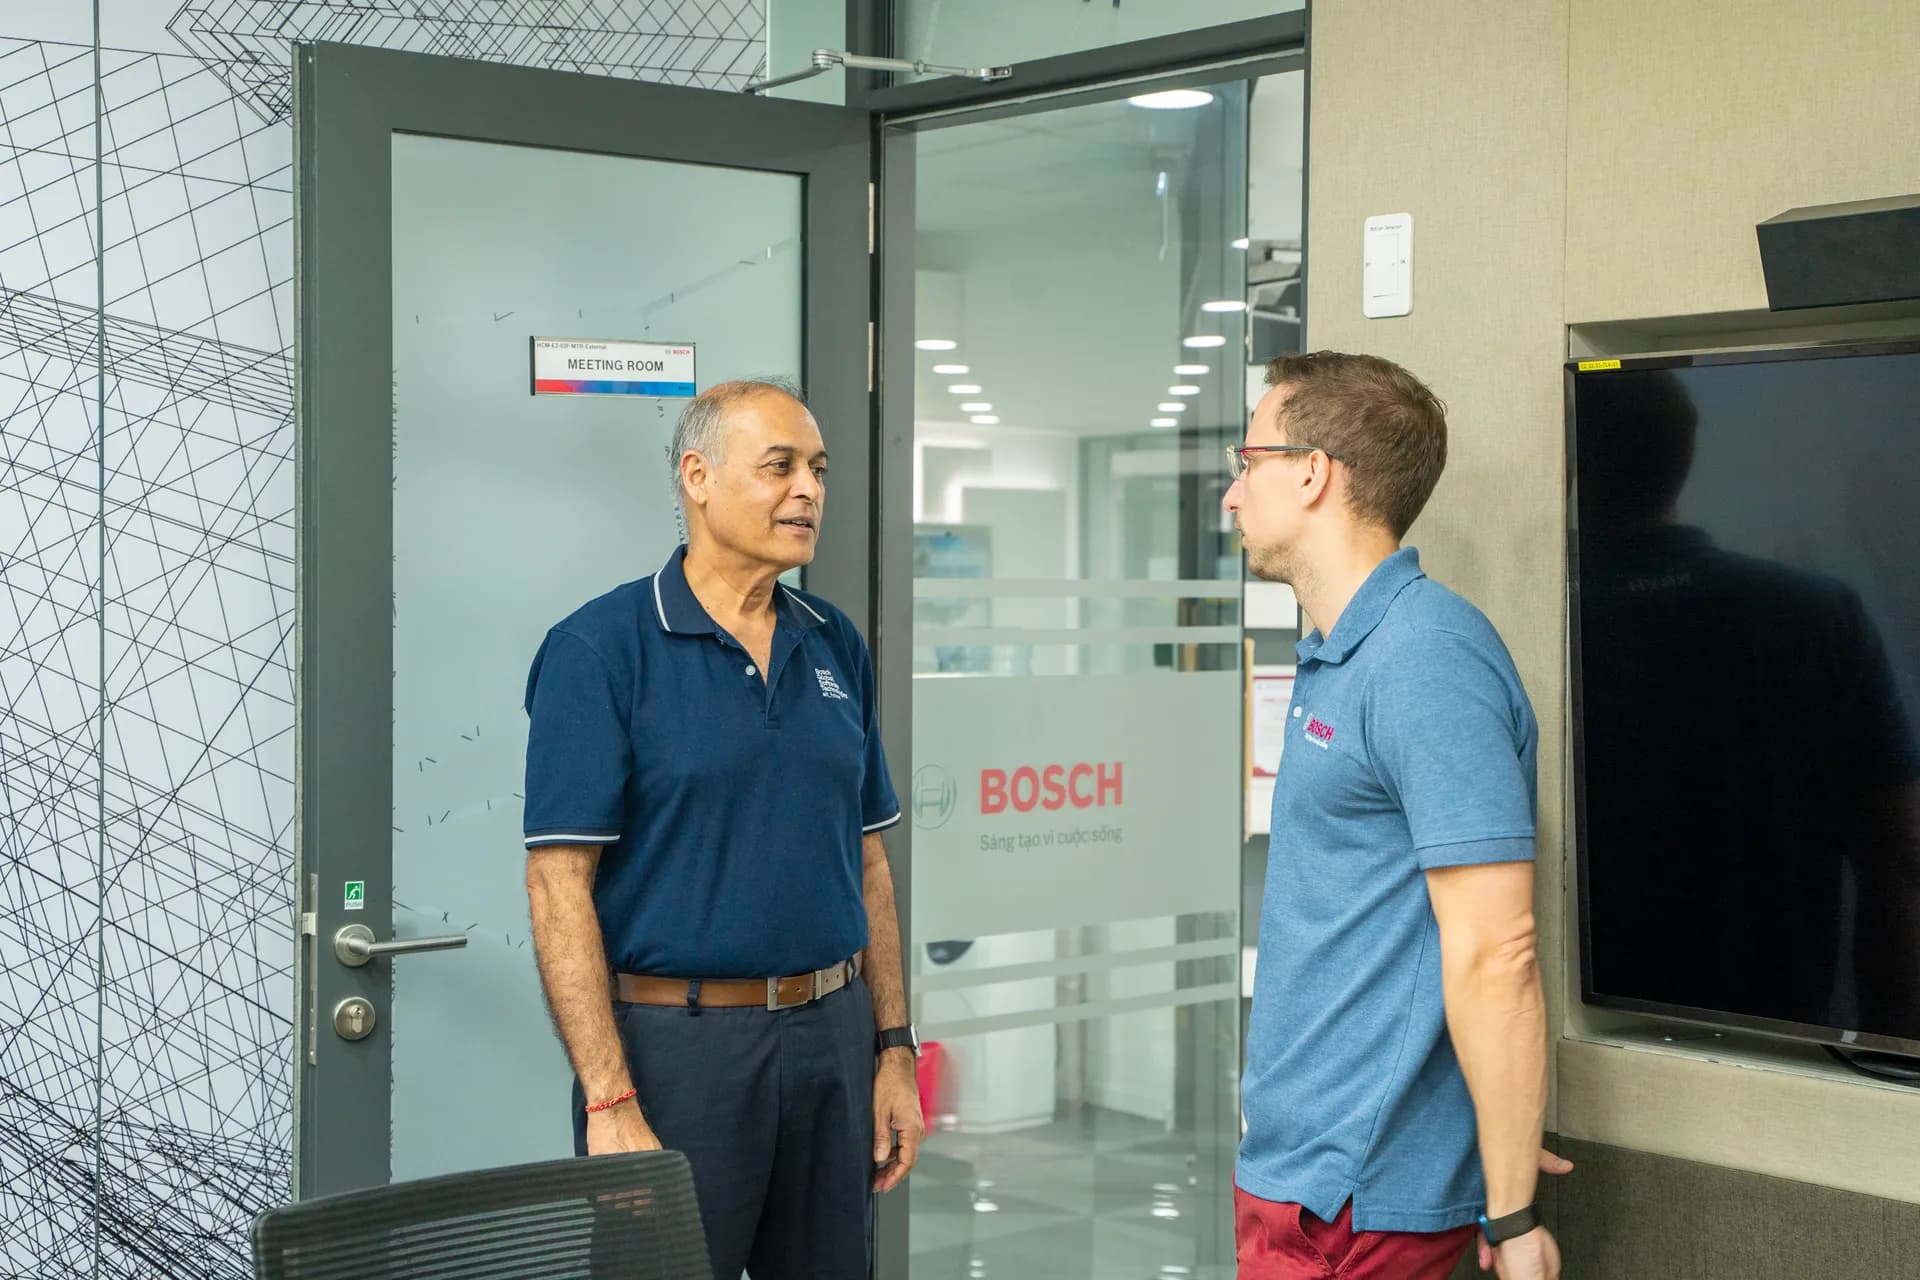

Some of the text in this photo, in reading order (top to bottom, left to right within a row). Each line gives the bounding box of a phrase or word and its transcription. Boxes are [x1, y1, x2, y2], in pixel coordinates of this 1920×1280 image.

[568, 359, 664, 372] MEETING ROOM
[1307, 717, 1335, 741] BOSCH
[980, 762, 1123, 814] BOSCH
[980, 833, 1015, 853] Sáng
[1018, 833, 1041, 853] tạo
